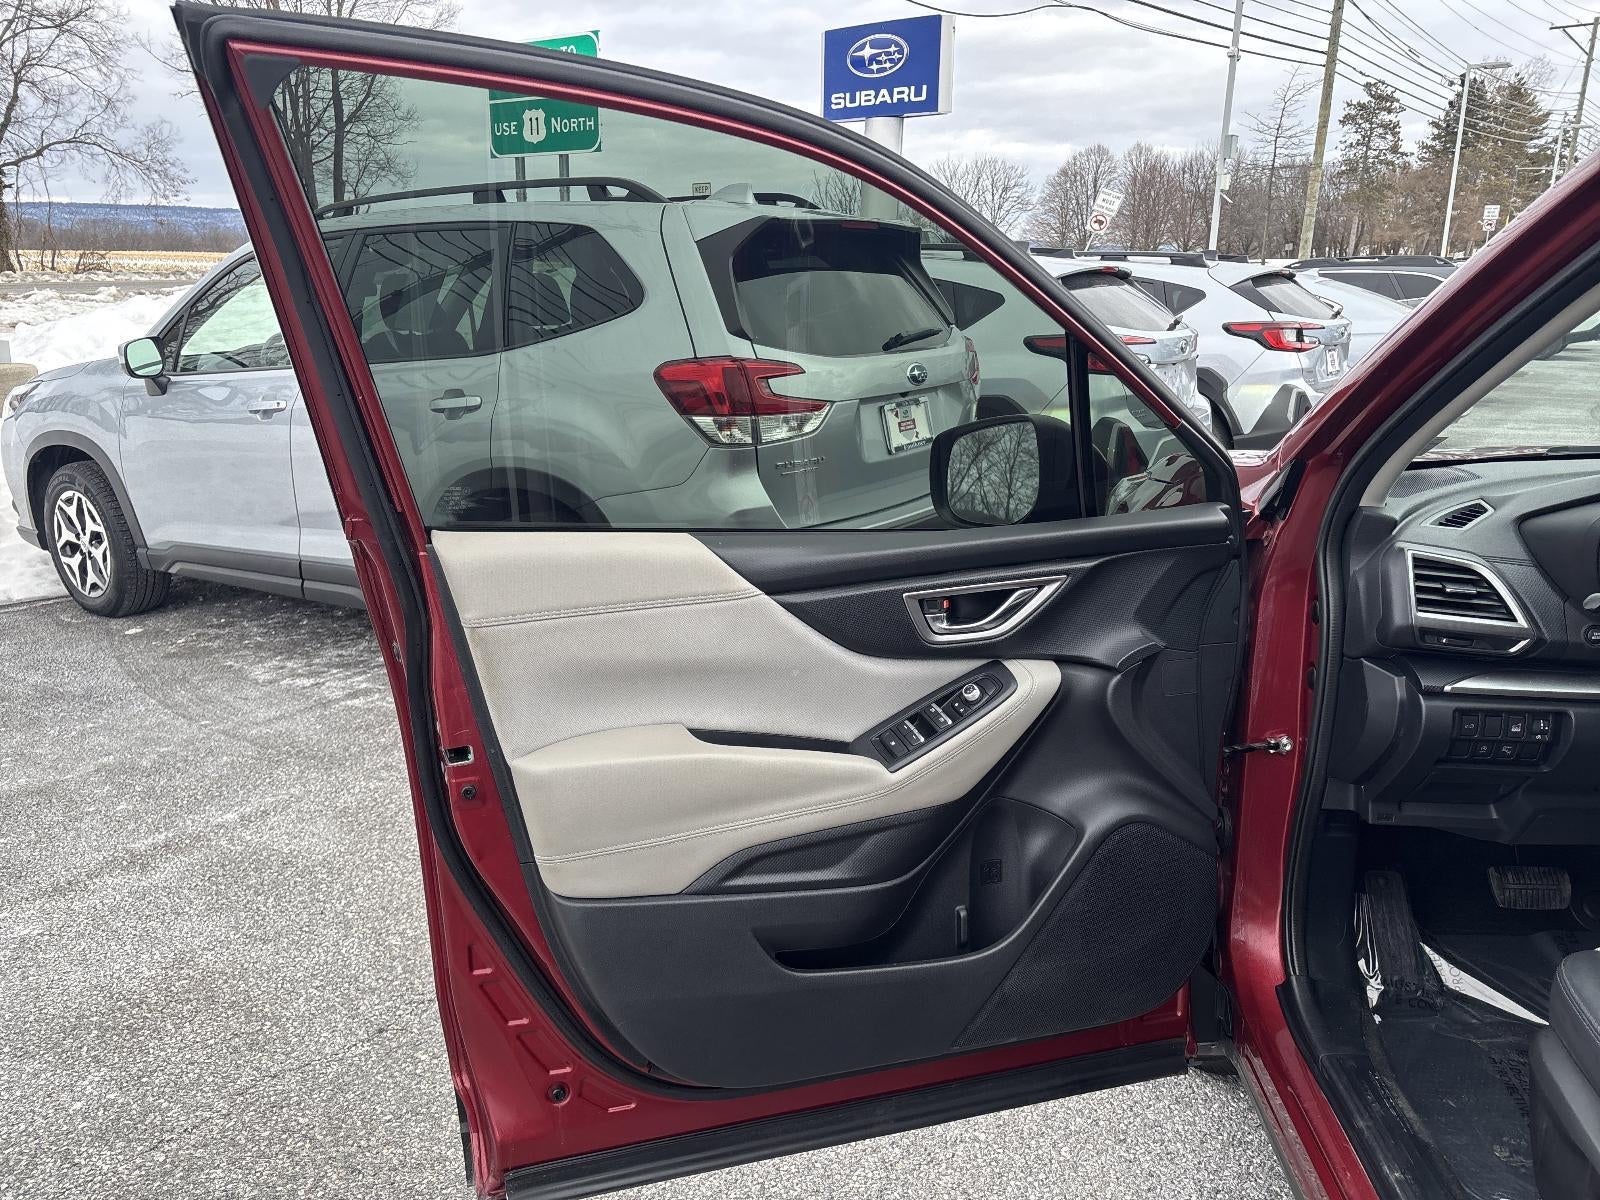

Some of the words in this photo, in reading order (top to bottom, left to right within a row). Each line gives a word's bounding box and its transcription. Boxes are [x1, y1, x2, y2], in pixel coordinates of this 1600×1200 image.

[831, 84, 927, 110] SUBARU
[494, 122, 518, 136] USE
[529, 116, 540, 135] 11
[551, 116, 595, 134] NORTH
[694, 185, 709, 193] KEEP
